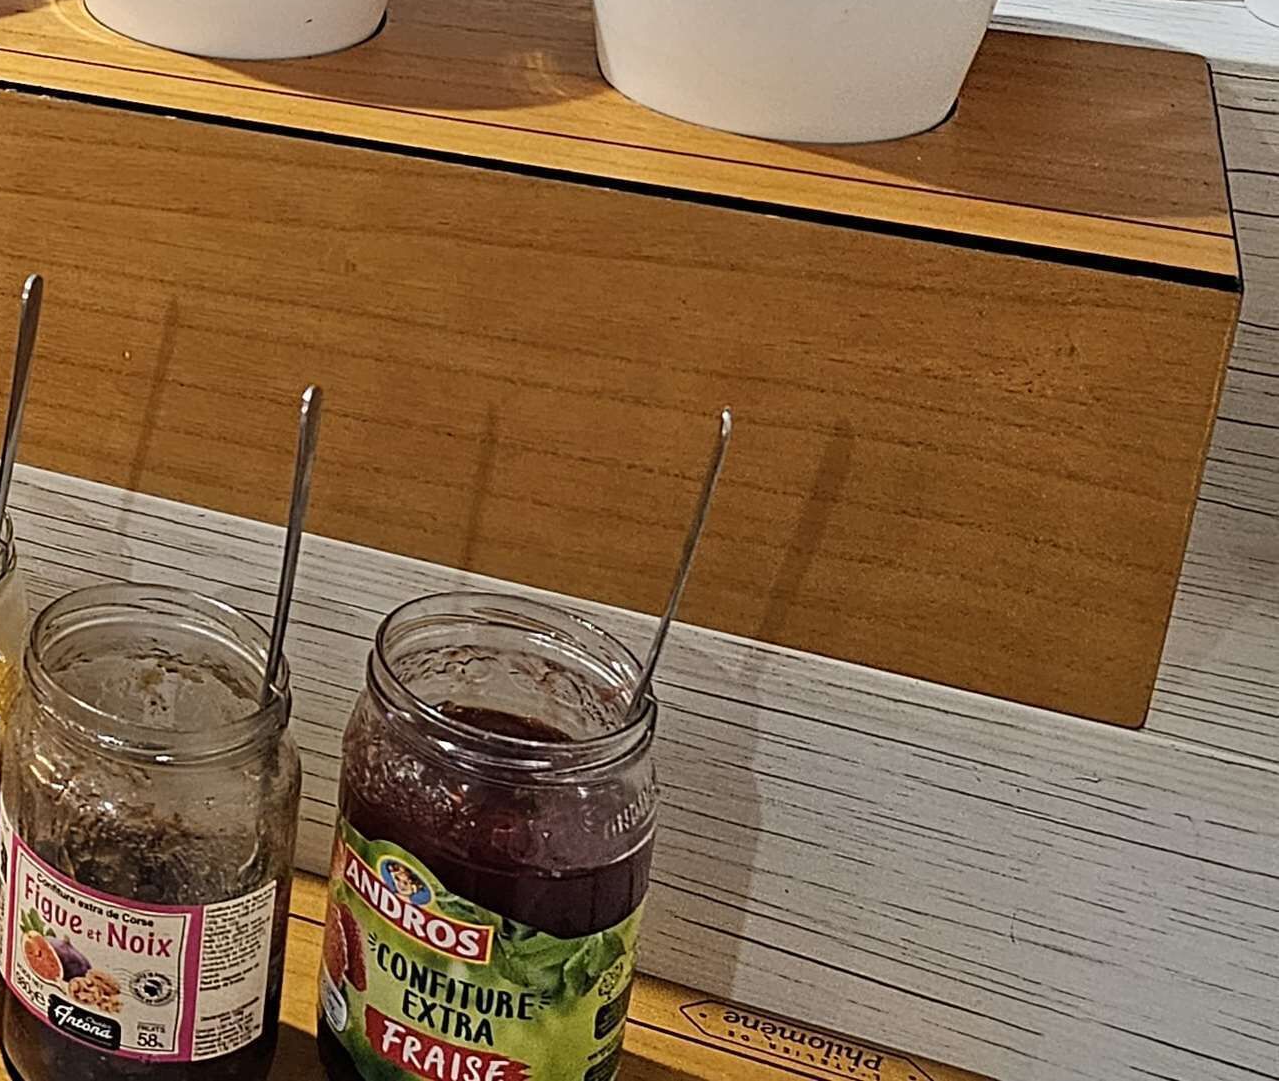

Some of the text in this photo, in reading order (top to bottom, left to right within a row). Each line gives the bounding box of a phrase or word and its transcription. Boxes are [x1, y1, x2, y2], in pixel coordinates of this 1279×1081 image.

[25, 873, 174, 958] Figue et Noix
[78, 900, 103, 916] extra
[106, 909, 120, 921] de
[121, 913, 154, 928] Corse
[345, 856, 481, 959] ANDROS
[376, 942, 536, 1021] CONFITURE
[53, 1004, 114, 1039] Antona
[401, 988, 495, 1047] EXTRA
[722, 1009, 884, 1071] Philomène
[380, 1018, 511, 1081] FRAISE
